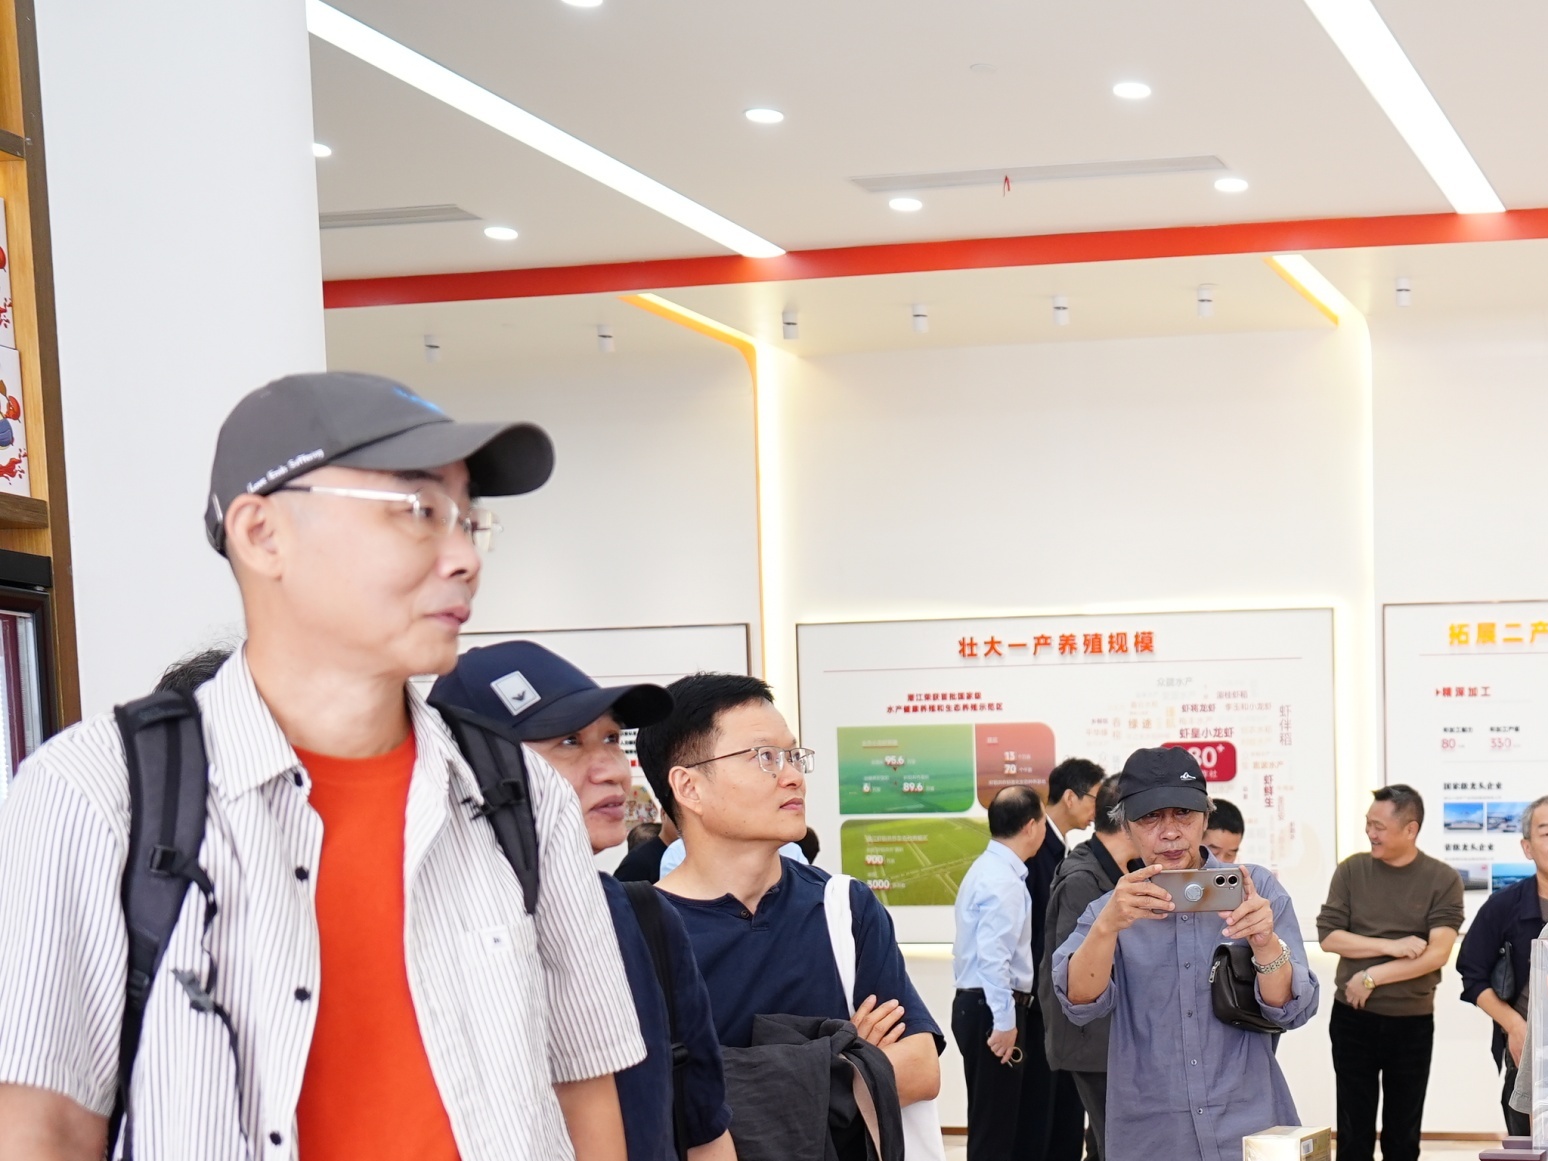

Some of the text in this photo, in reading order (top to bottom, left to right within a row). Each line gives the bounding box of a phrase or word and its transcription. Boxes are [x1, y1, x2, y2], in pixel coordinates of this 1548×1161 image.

[958, 631, 1155, 658] 壮大一产养殖规模
[1442, 686, 1491, 697] 精深加工
[902, 782, 924, 792] 89.6
